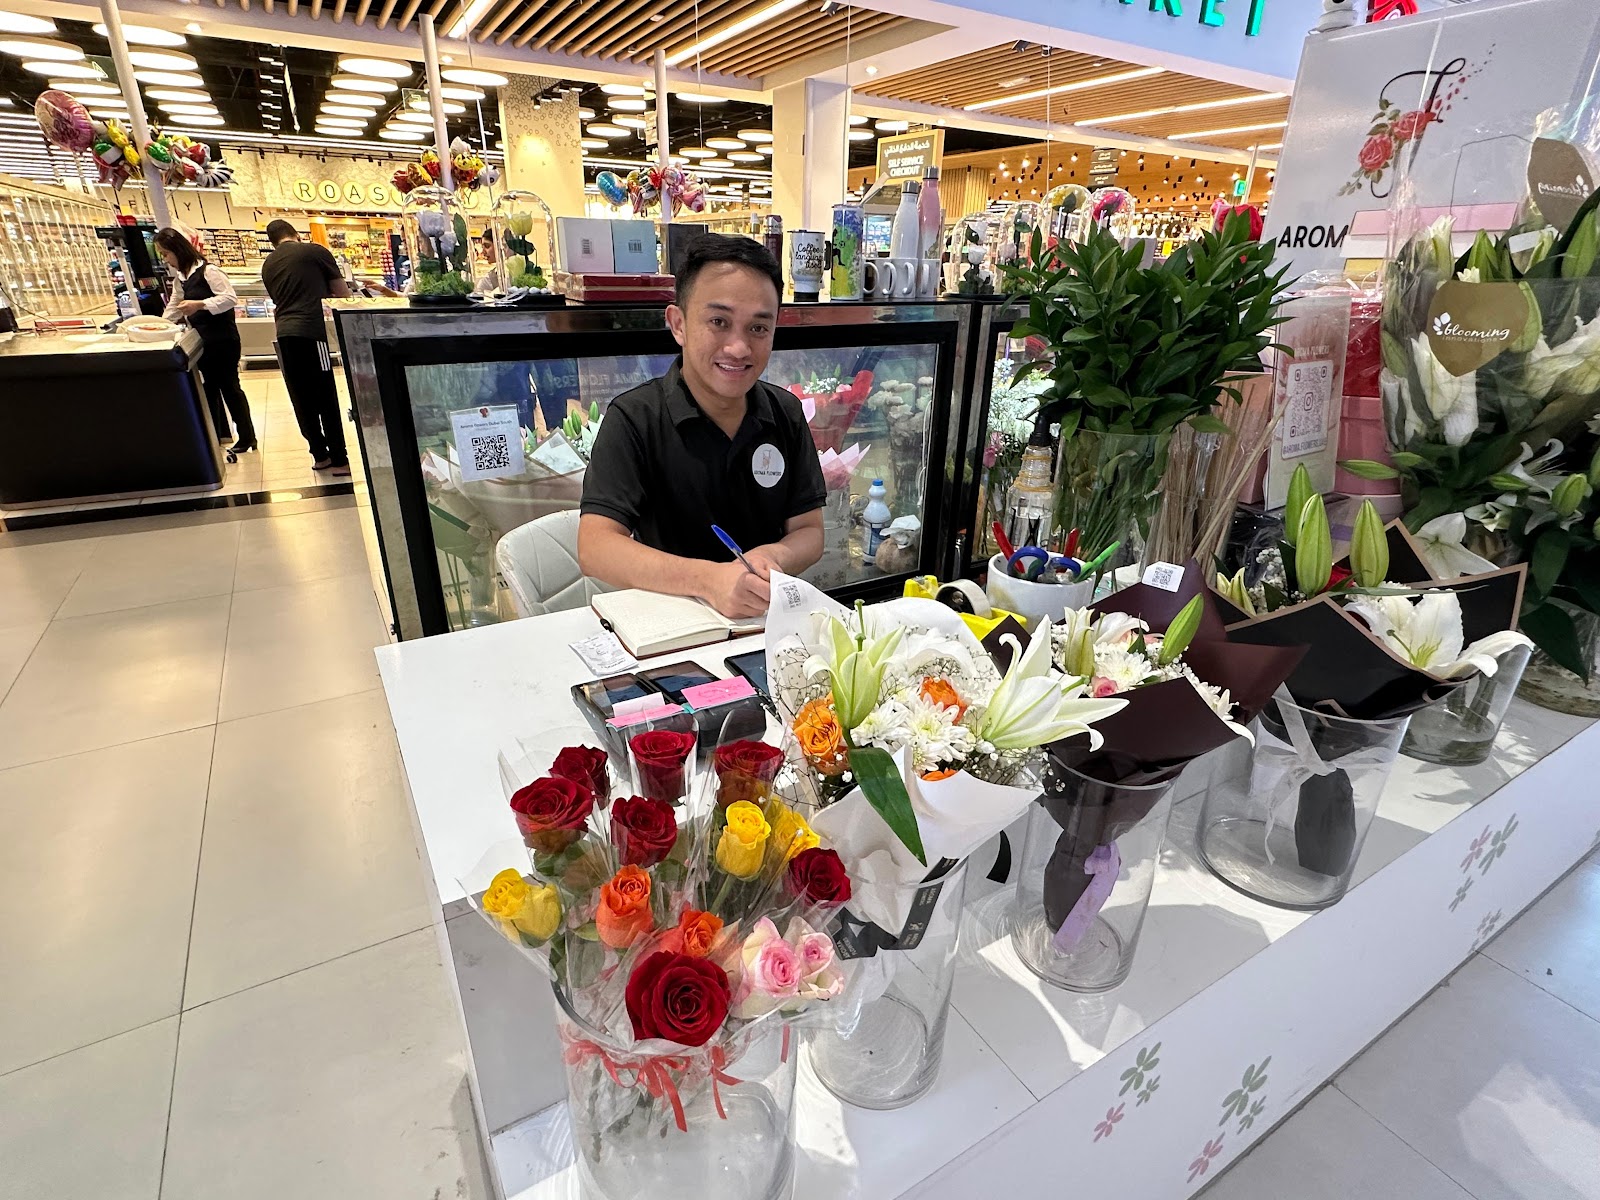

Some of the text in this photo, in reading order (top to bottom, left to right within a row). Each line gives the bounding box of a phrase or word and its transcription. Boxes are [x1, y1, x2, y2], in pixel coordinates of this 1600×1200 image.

[888, 155, 924, 169] SELF SERVICE
[890, 165, 920, 177] CHECKOUT
[1277, 225, 1349, 248] AROM
[1444, 322, 1511, 341] blooming
